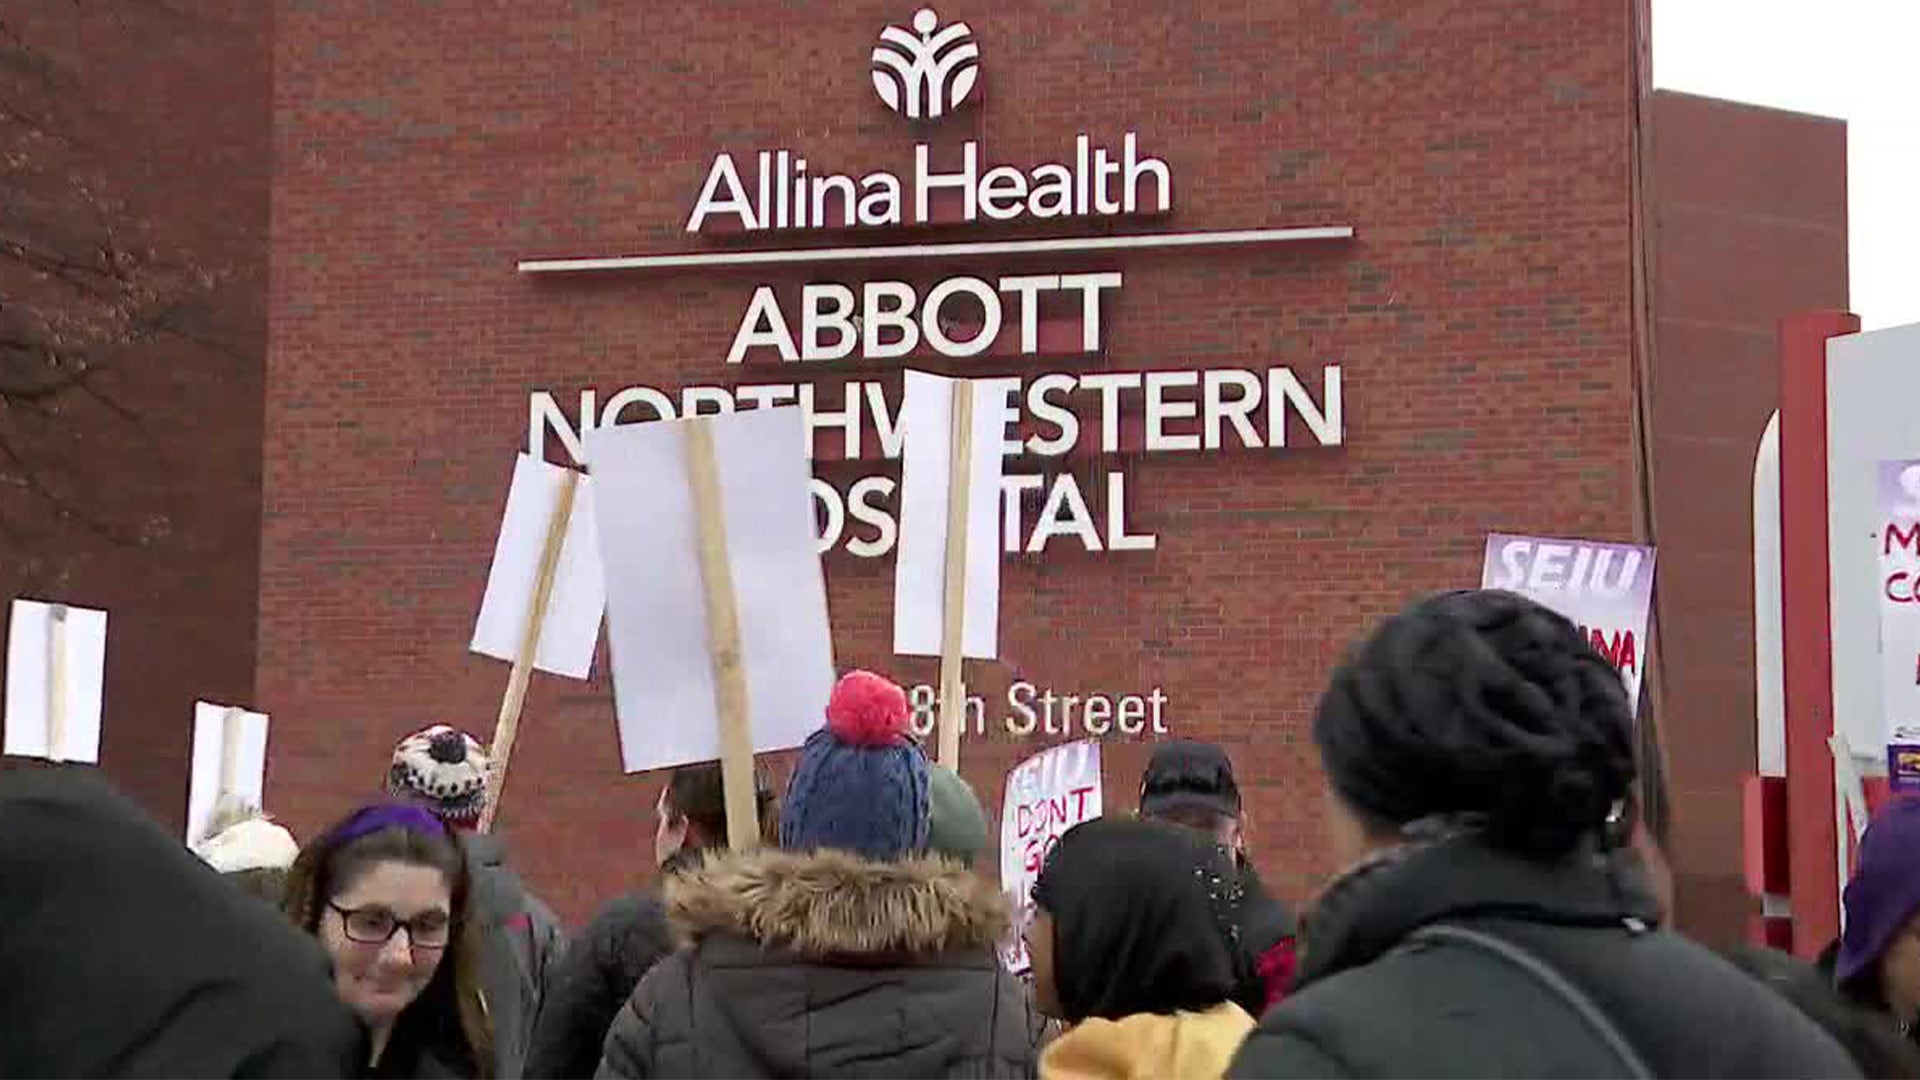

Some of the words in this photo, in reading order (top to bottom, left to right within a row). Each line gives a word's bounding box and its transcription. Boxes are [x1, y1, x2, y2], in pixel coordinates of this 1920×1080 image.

[685, 149, 900, 232] Allina
[914, 132, 1171, 222] Health
[726, 272, 1122, 364] ABBOTT
[1493, 540, 1642, 591] SEIU
[1004, 681, 1169, 736] Street
[1017, 786, 1095, 838] DONT
